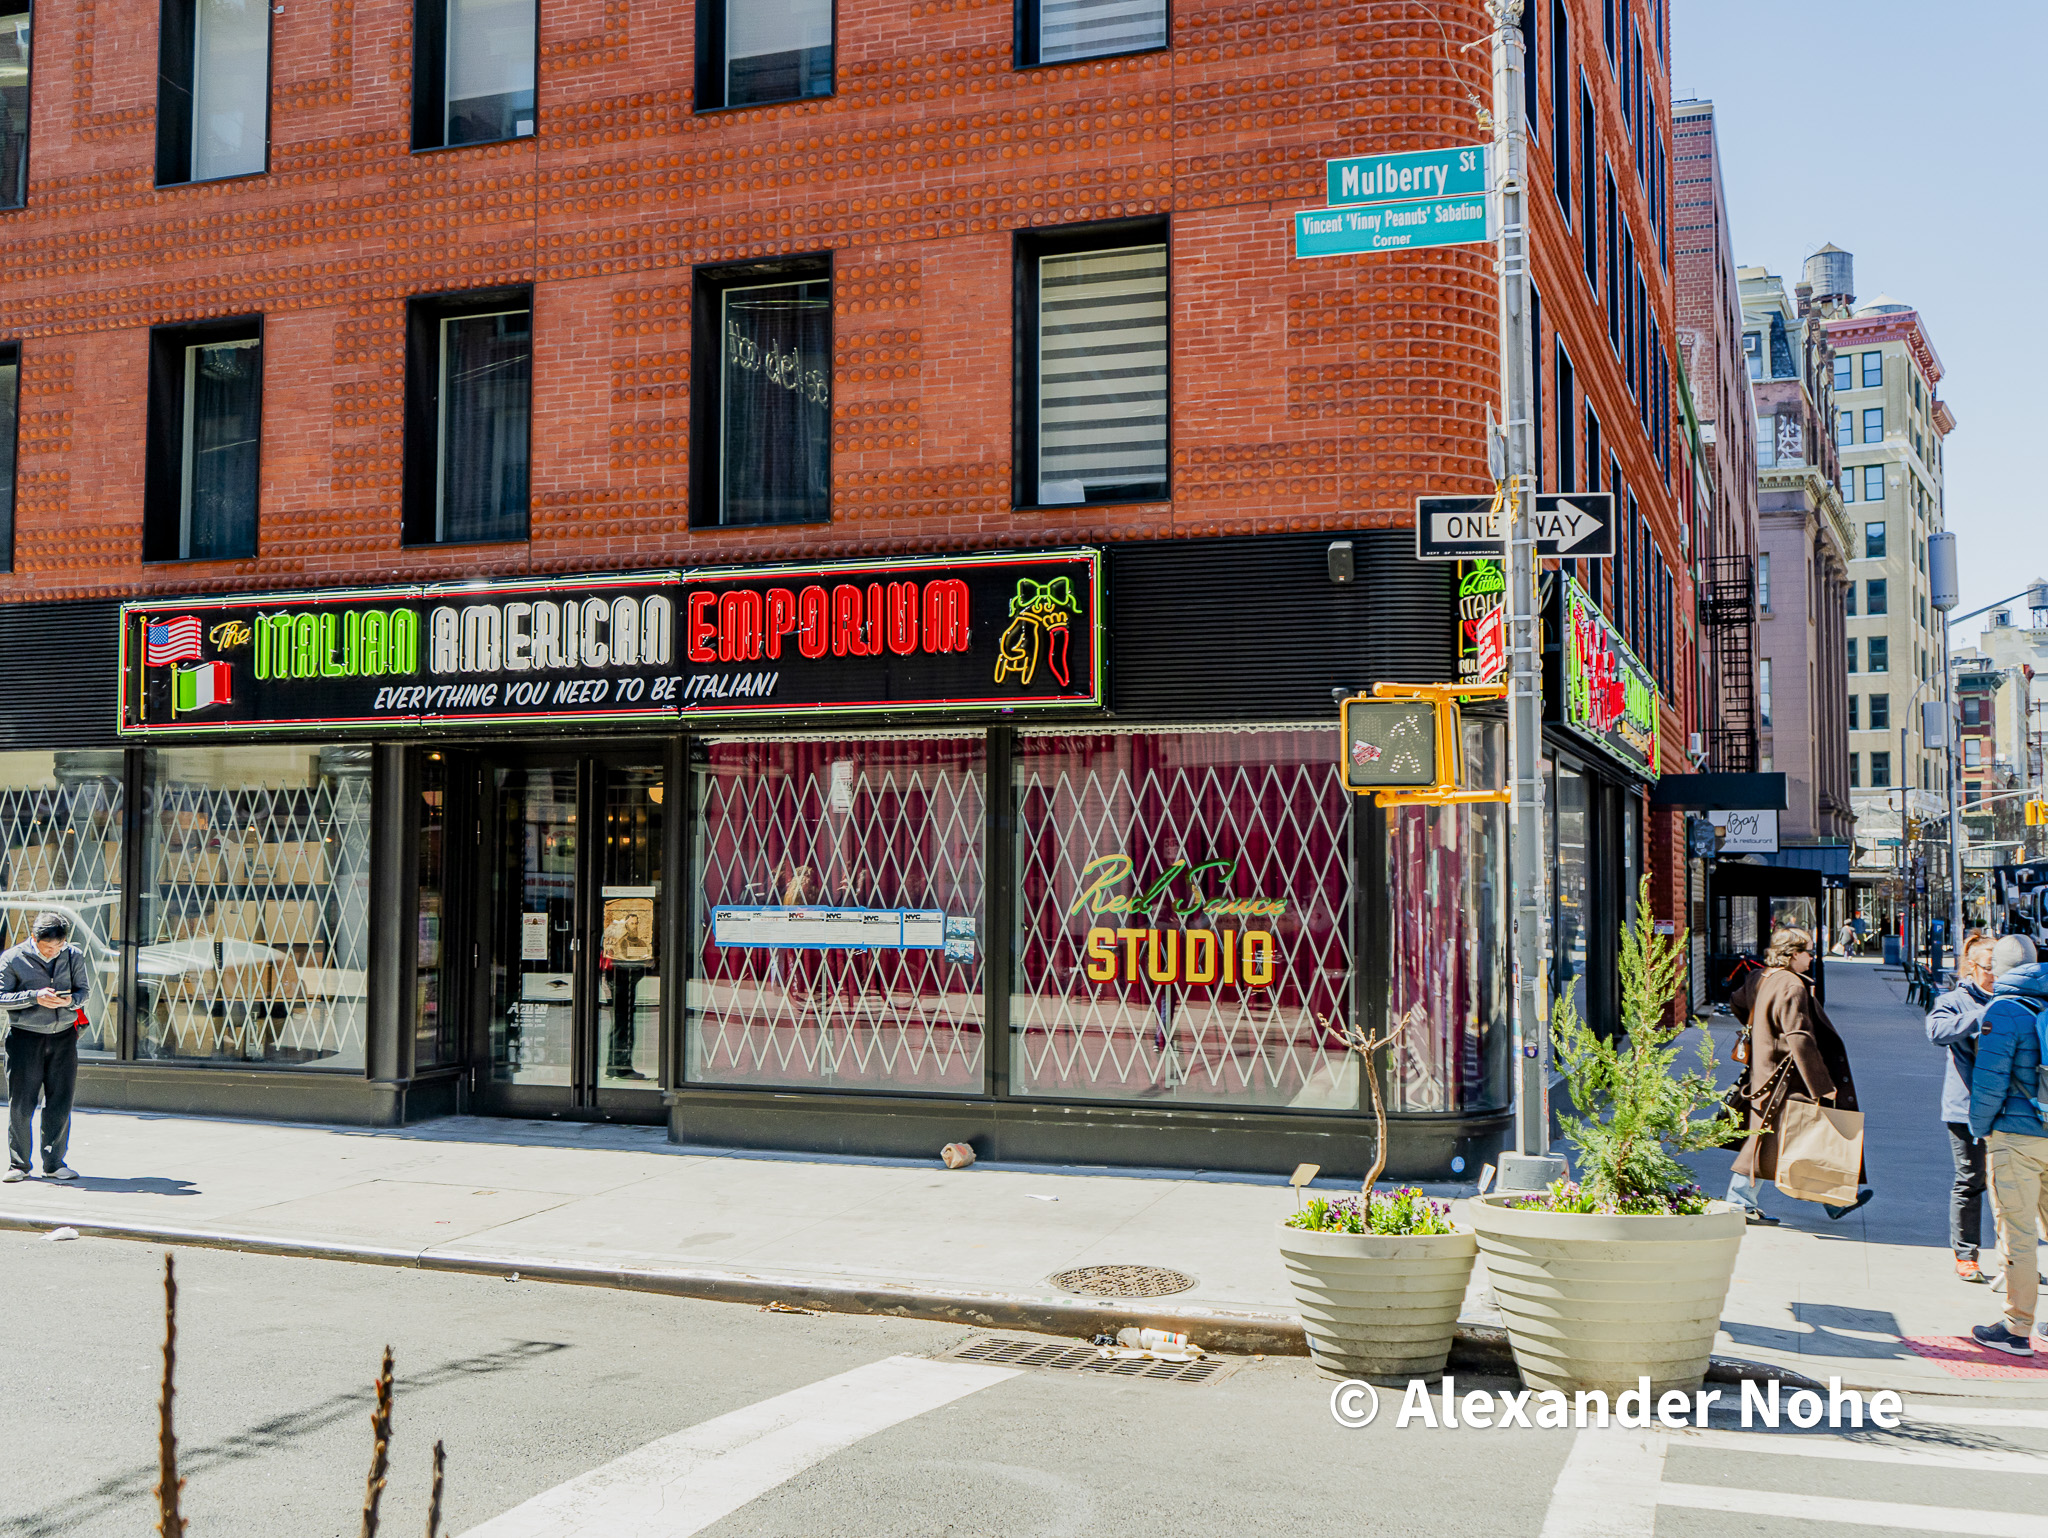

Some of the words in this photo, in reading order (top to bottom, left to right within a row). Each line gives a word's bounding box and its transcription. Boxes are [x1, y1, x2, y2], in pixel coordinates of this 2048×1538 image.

[1342, 162, 1448, 197] Mulberry
[1459, 151, 1476, 172] St
[1302, 215, 1343, 235] Vincent
[1346, 209, 1382, 233] 'Vinny
[1385, 206, 1431, 228] Peanuts'
[1435, 203, 1483, 223] Sabatino
[1373, 234, 1412, 248] Corner
[1447, 516, 1500, 538] ONE
[1464, 567, 1503, 594] Little
[210, 620, 251, 652] The
[254, 608, 418, 680] ITALIAN
[430, 594, 671, 674] AMERICAN
[688, 579, 970, 662] EMPORIUM
[374, 683, 498, 709] EVERYTHING
[504, 681, 550, 706] YOU
[553, 678, 609, 704] NEED
[615, 677, 645, 702] TO
[651, 676, 682, 700] BE
[684, 671, 779, 698] ITALIAN!
[1726, 811, 1760, 835] Baz
[1071, 853, 1187, 916] Red
[1173, 858, 1288, 916] Sauce
[1936, 924, 1943, 932] P
[1087, 927, 1276, 988] STUDIO
